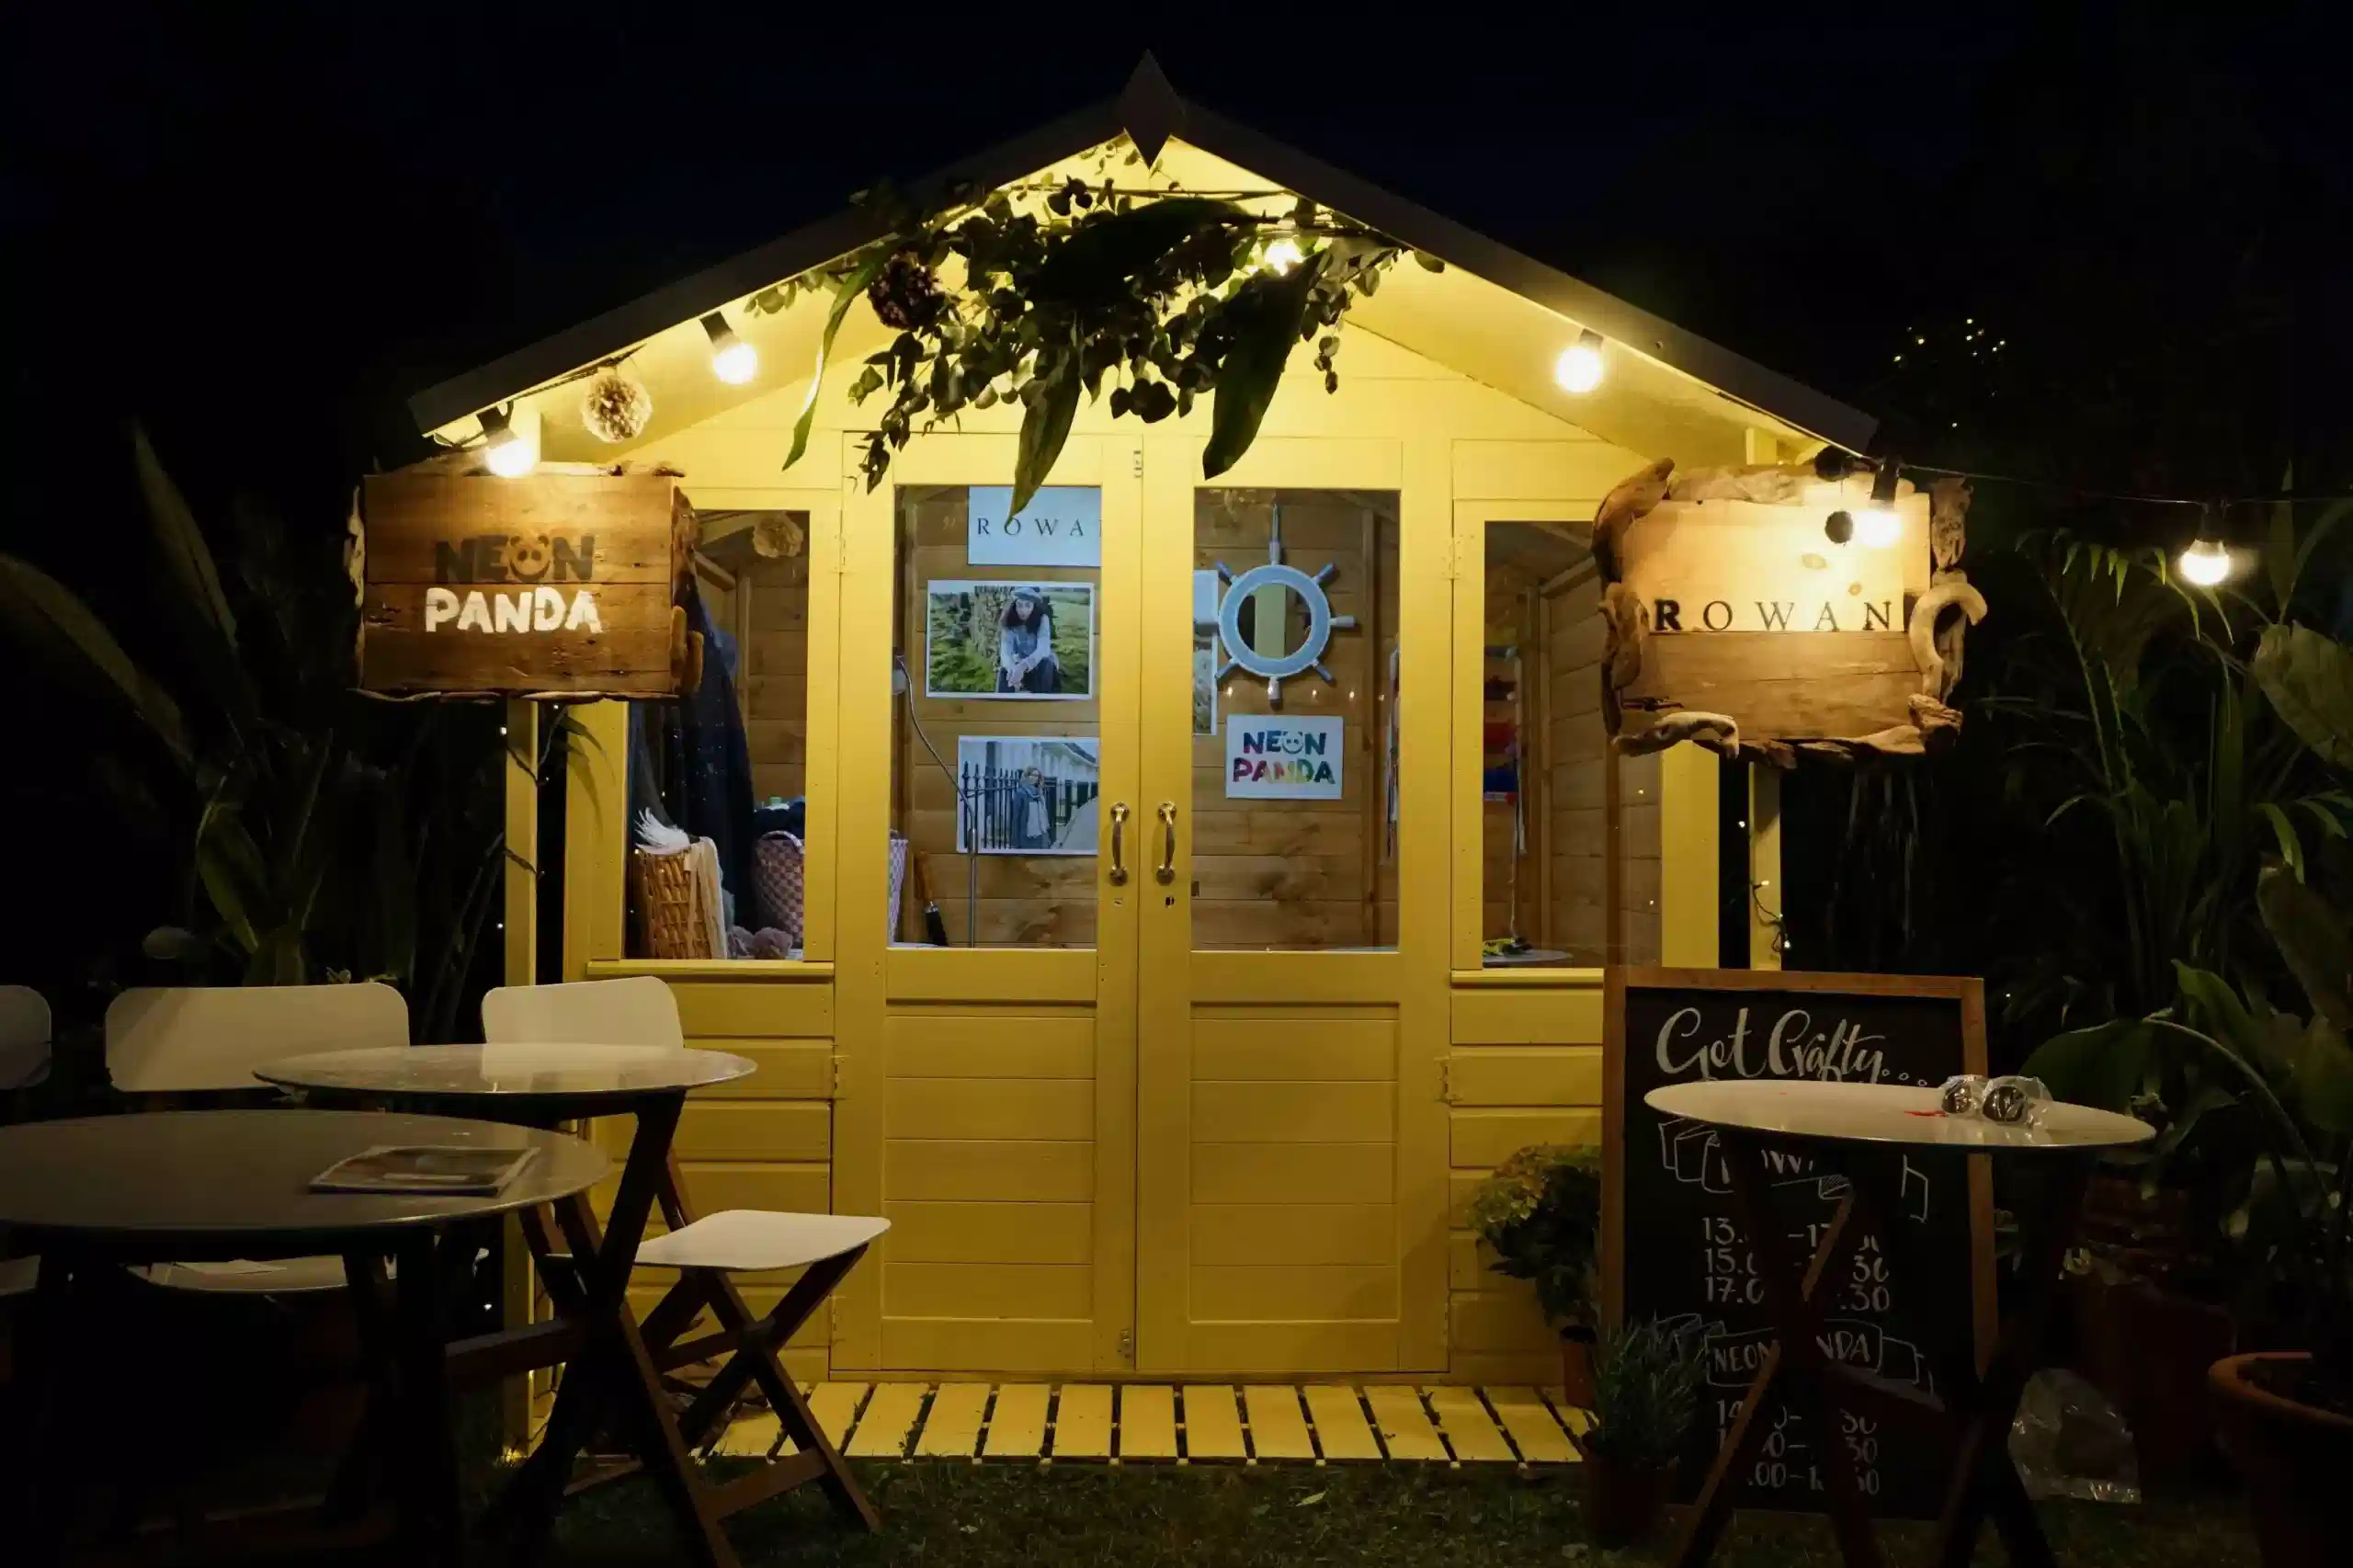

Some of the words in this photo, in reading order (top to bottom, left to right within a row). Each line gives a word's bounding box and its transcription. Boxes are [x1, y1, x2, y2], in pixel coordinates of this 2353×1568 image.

[977, 517, 1102, 538] ROWA
[433, 533, 596, 585] NEON
[424, 585, 604, 634] PANDA
[1654, 598, 1893, 632] ROWAN
[1243, 730, 1327, 756] NEON
[1232, 756, 1336, 785] PANDA
[1655, 1006, 1767, 1082] Get
